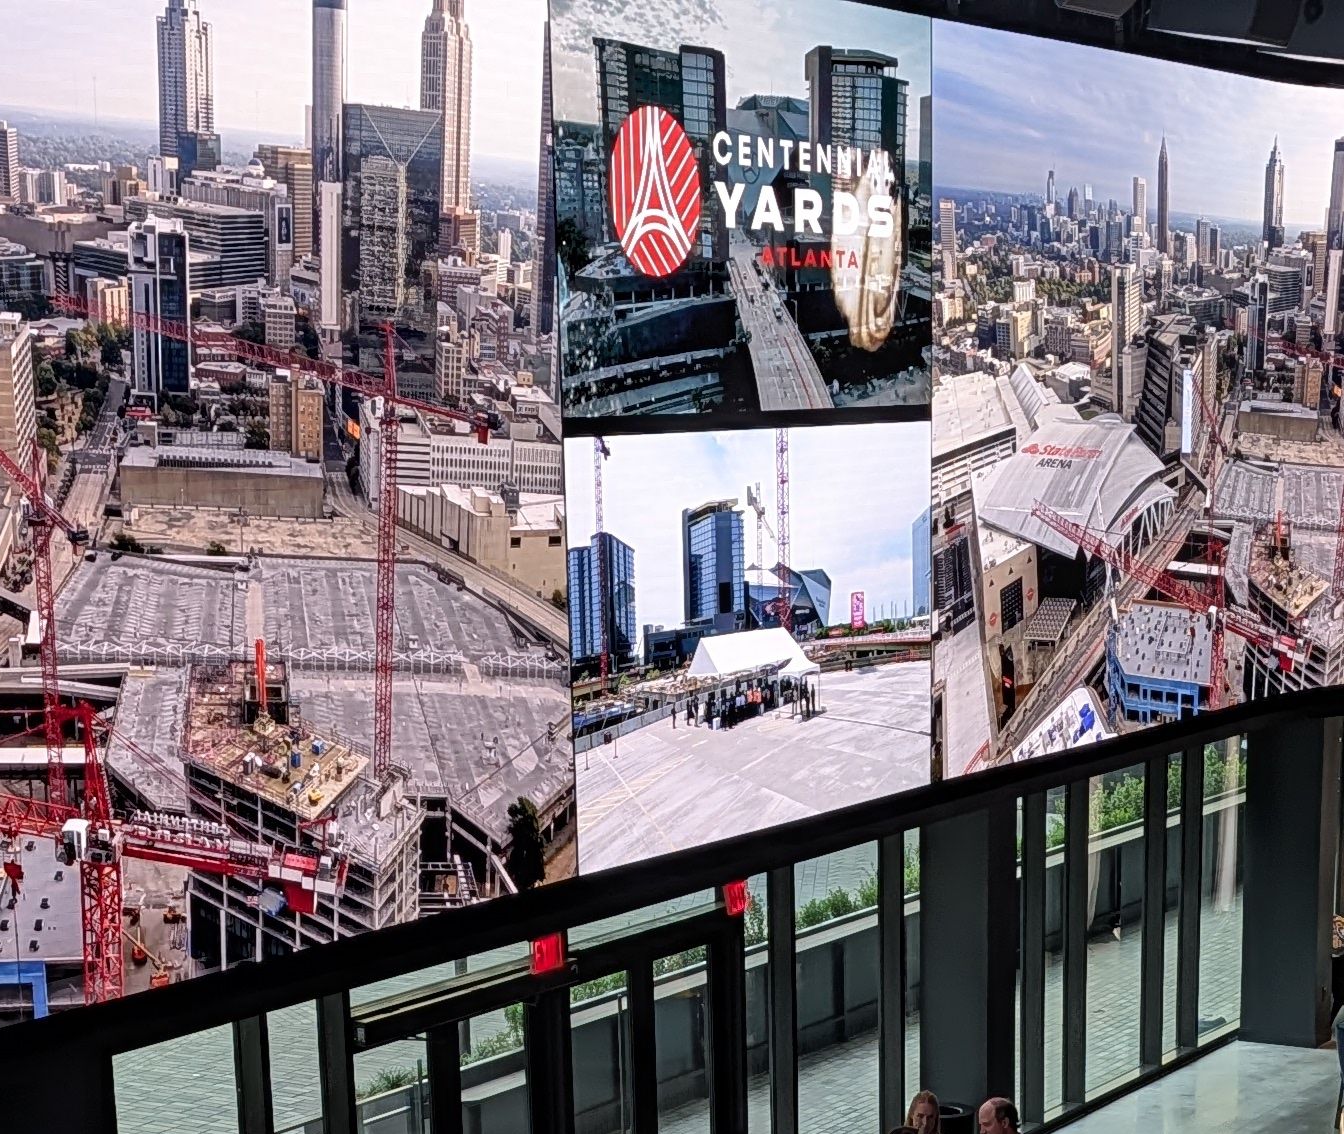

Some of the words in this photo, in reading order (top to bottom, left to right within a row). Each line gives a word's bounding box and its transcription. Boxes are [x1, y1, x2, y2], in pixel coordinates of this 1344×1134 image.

[712, 130, 894, 182] CENTENNIAL
[713, 181, 894, 238] YARDS
[761, 246, 859, 270] ATLANTA
[1036, 458, 1073, 469] ARENA
